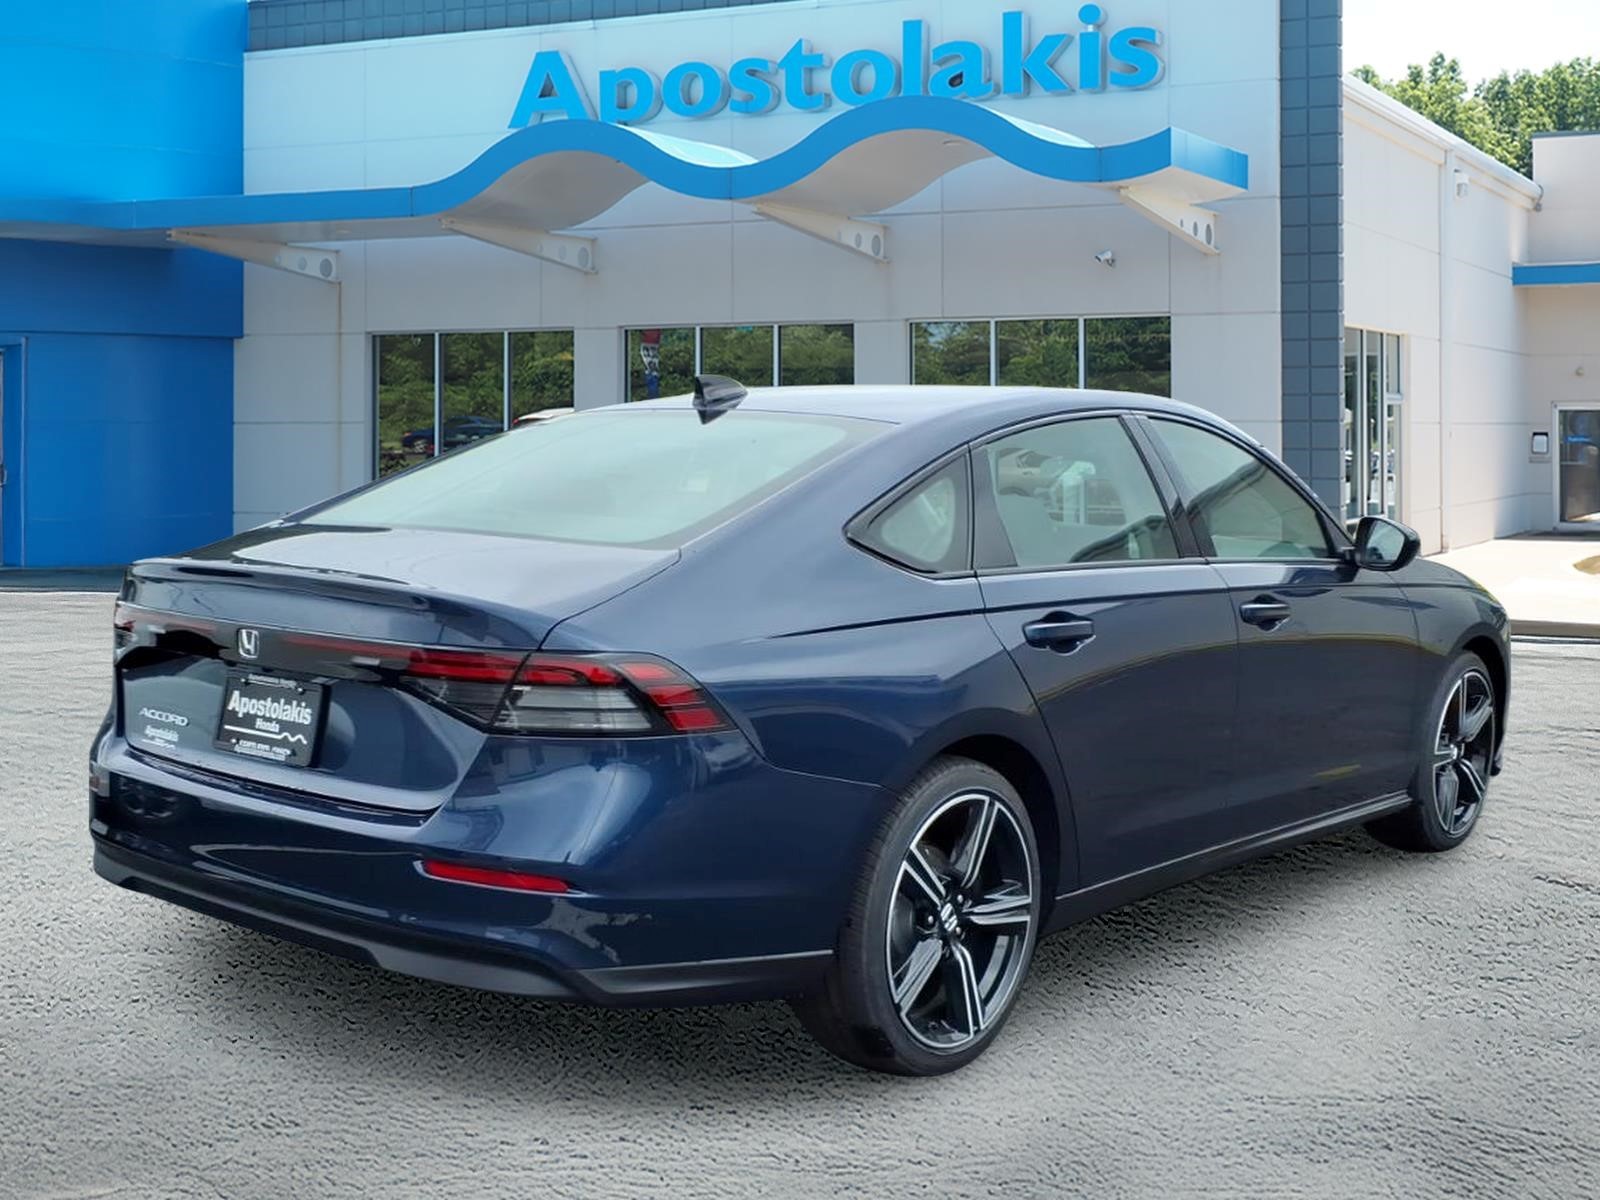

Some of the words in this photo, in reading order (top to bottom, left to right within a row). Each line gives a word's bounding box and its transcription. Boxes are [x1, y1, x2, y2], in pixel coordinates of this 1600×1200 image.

[508, 4, 1163, 128] Apostolakis
[139, 707, 188, 726] ACCORD
[228, 690, 312, 725] Apostolakis
